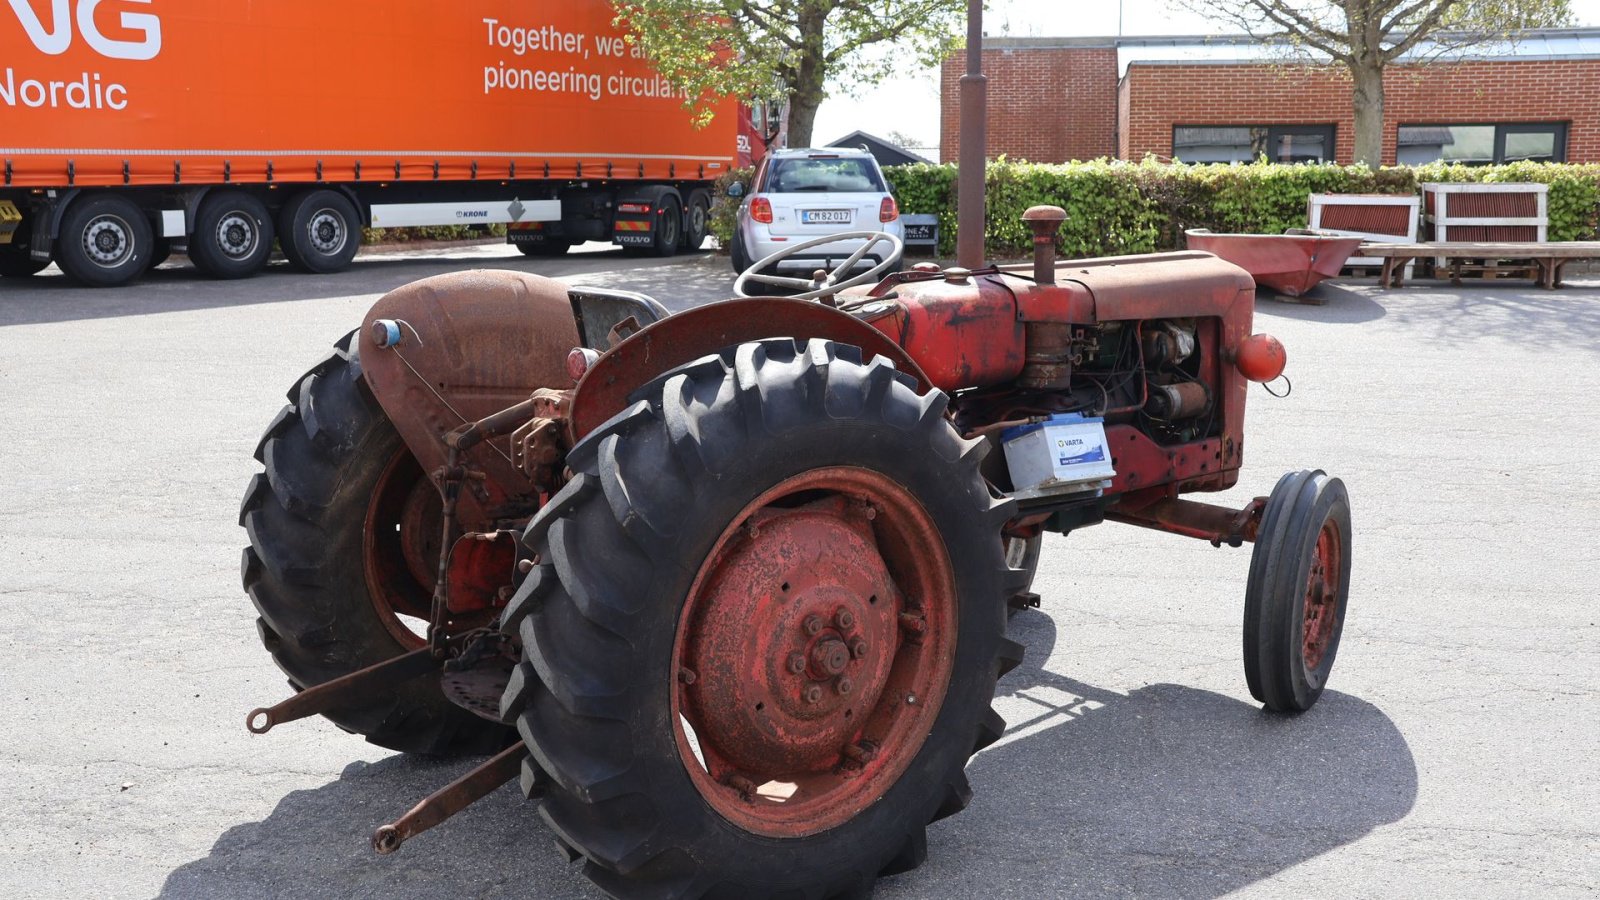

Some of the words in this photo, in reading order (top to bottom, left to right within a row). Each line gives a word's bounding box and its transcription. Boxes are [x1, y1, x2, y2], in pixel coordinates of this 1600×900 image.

[483, 17, 590, 60] Together,
[595, 35, 624, 57] we
[484, 61, 601, 100] pioneering
[463, 210, 488, 218] KRONE
[809, 211, 821, 220] CM
[821, 211, 832, 220] 82
[833, 211, 849, 220] 017
[510, 234, 544, 242] VOLVO
[615, 234, 651, 243] VOLVO
[1064, 438, 1084, 446] VARTA
